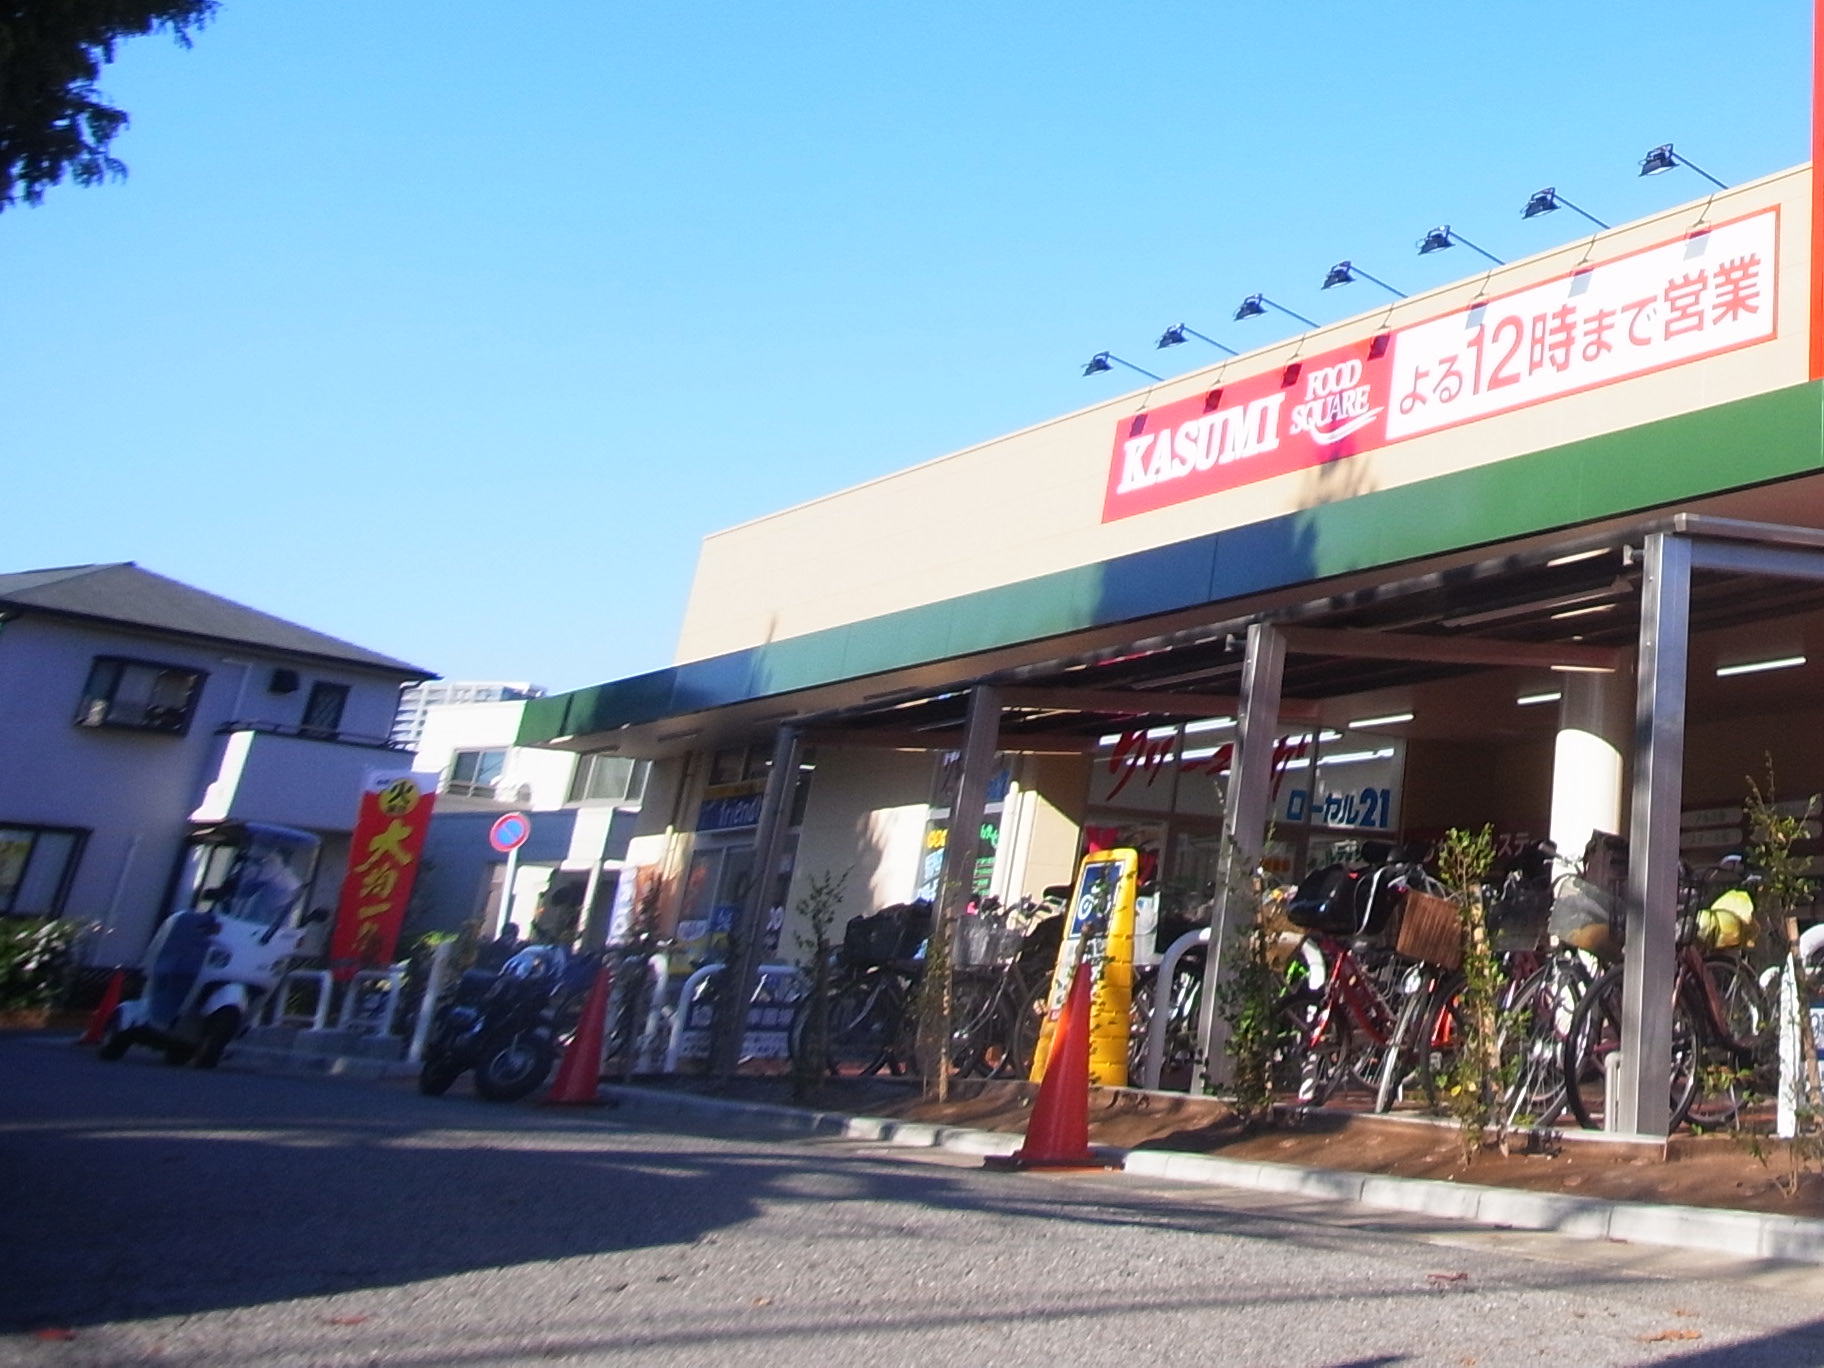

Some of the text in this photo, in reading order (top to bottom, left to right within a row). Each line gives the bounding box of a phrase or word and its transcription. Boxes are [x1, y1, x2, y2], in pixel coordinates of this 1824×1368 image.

[1400, 253, 1762, 415] よる12時まで営業
[1290, 385, 1371, 436] SQUARE
[1304, 358, 1363, 401] FOOD
[1117, 392, 1286, 494] KASUMI
